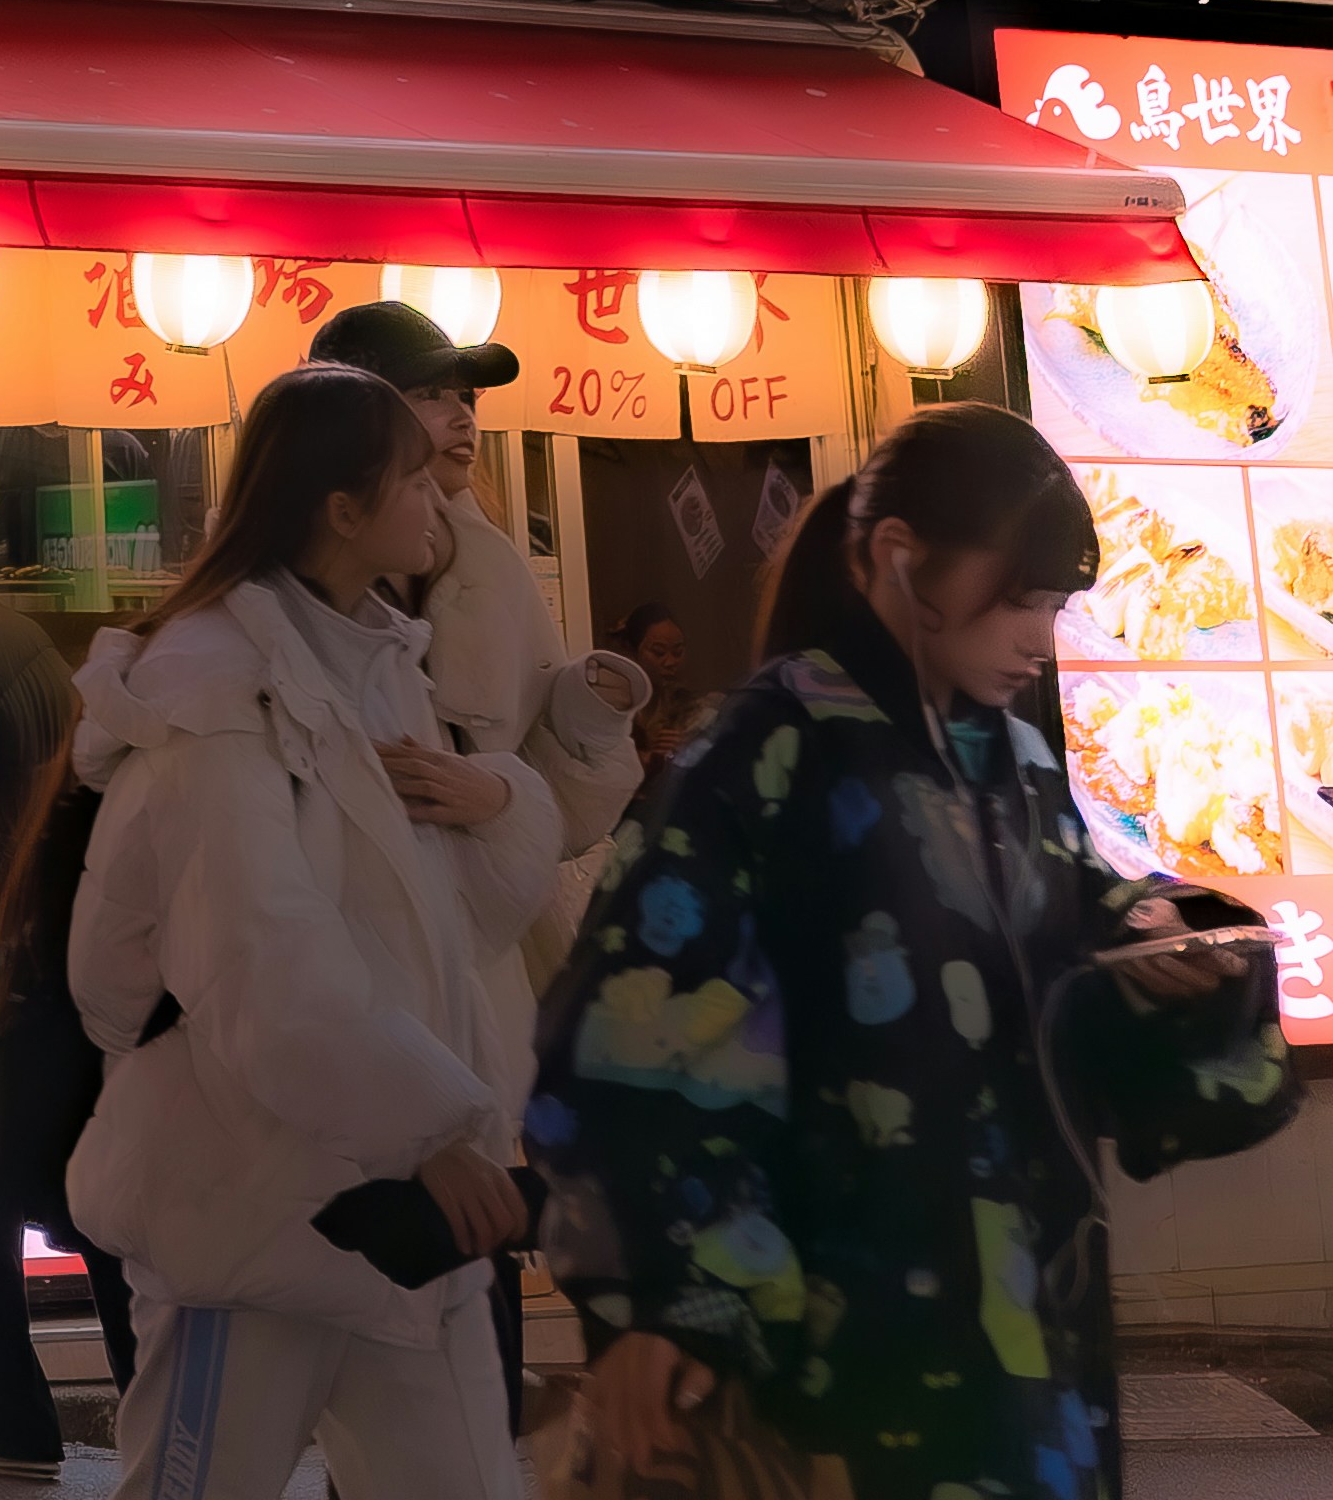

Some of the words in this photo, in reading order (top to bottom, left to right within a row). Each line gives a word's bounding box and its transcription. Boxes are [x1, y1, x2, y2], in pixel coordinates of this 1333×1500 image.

[1130, 62, 1301, 157] 鳥世界
[548, 366, 649, 421] 20%
[709, 374, 790, 423] OFF
